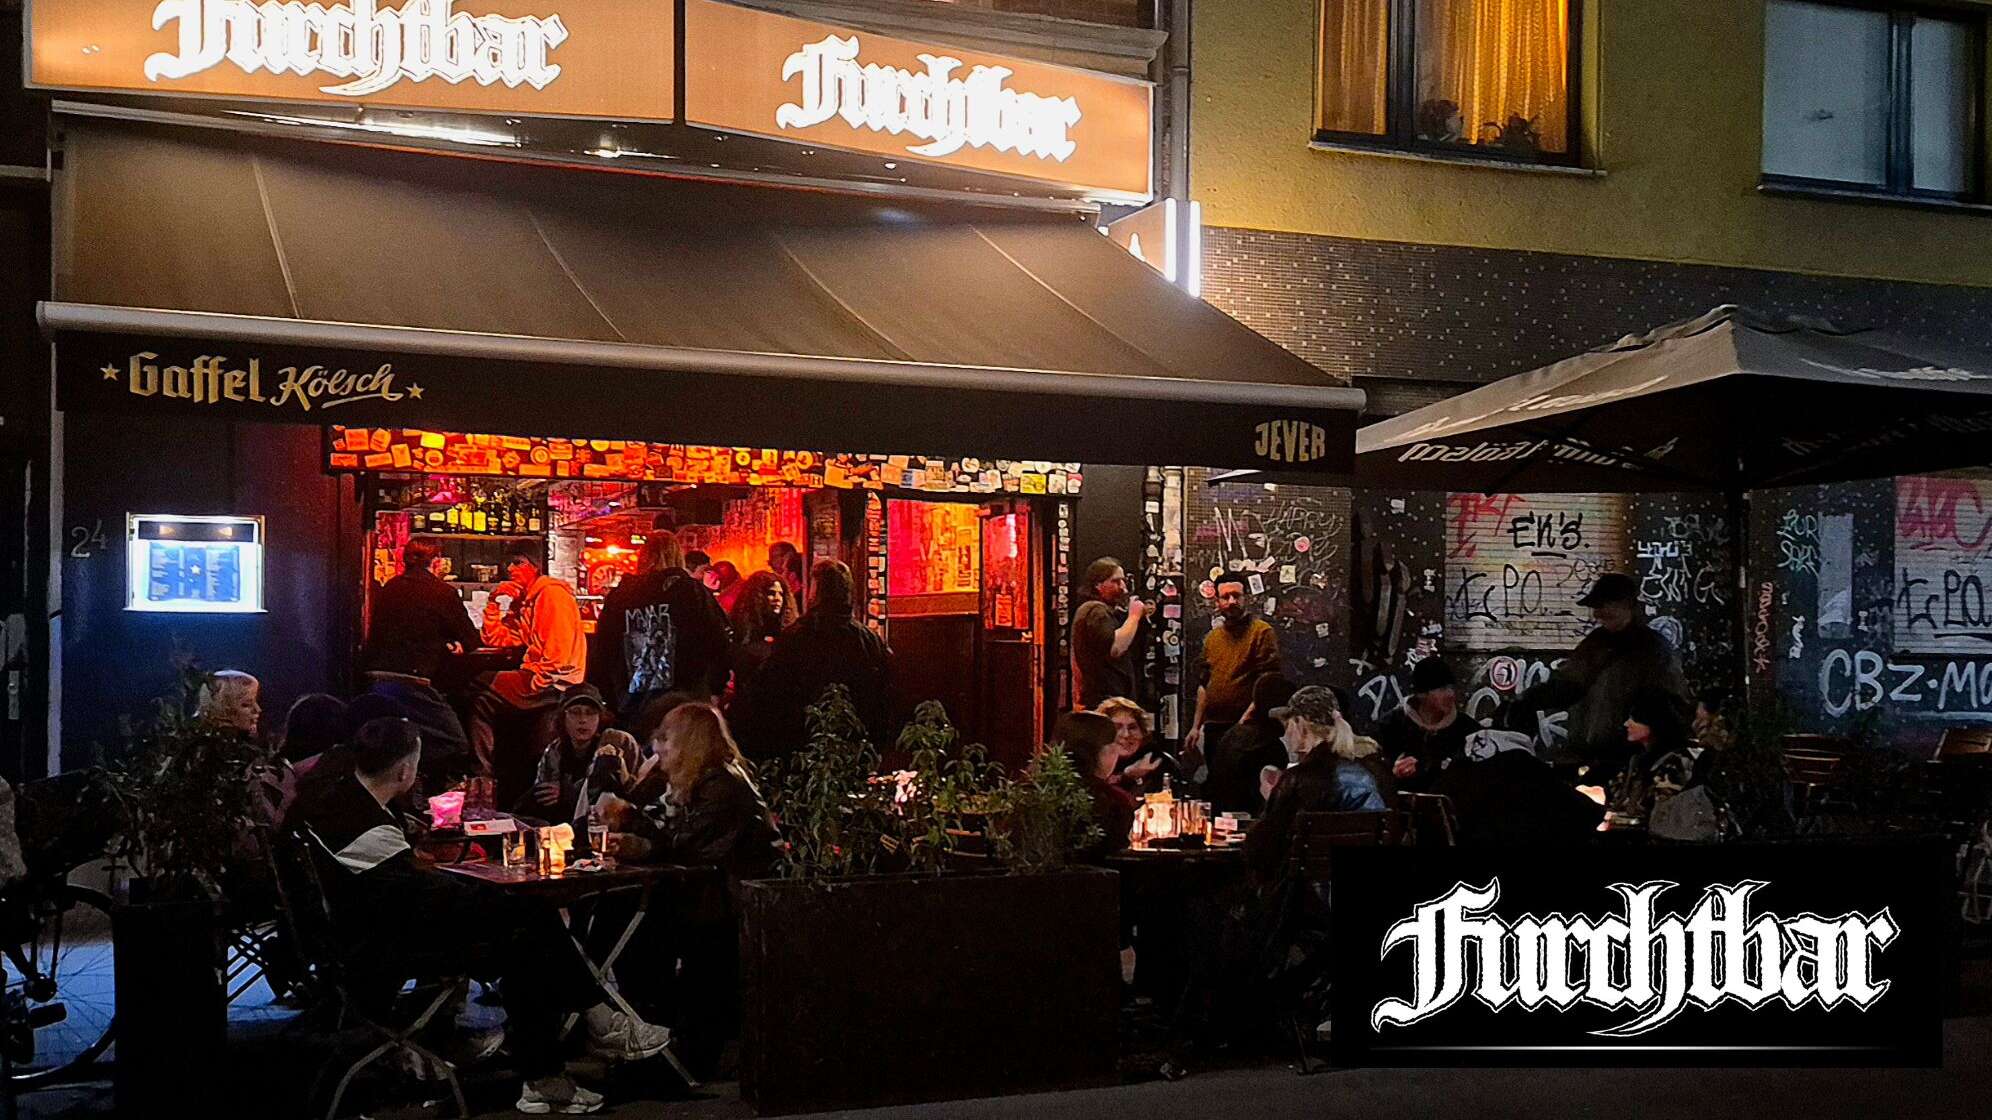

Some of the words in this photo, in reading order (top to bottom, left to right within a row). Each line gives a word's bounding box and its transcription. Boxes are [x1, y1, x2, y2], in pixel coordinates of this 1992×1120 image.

[143, 0, 569, 96] Furchtbar
[776, 34, 1082, 163] Furchtbar
[129, 351, 266, 404] Gaffel
[269, 363, 403, 411] Kölsch
[1255, 419, 1326, 463] JEVER
[71, 520, 107, 558] 24
